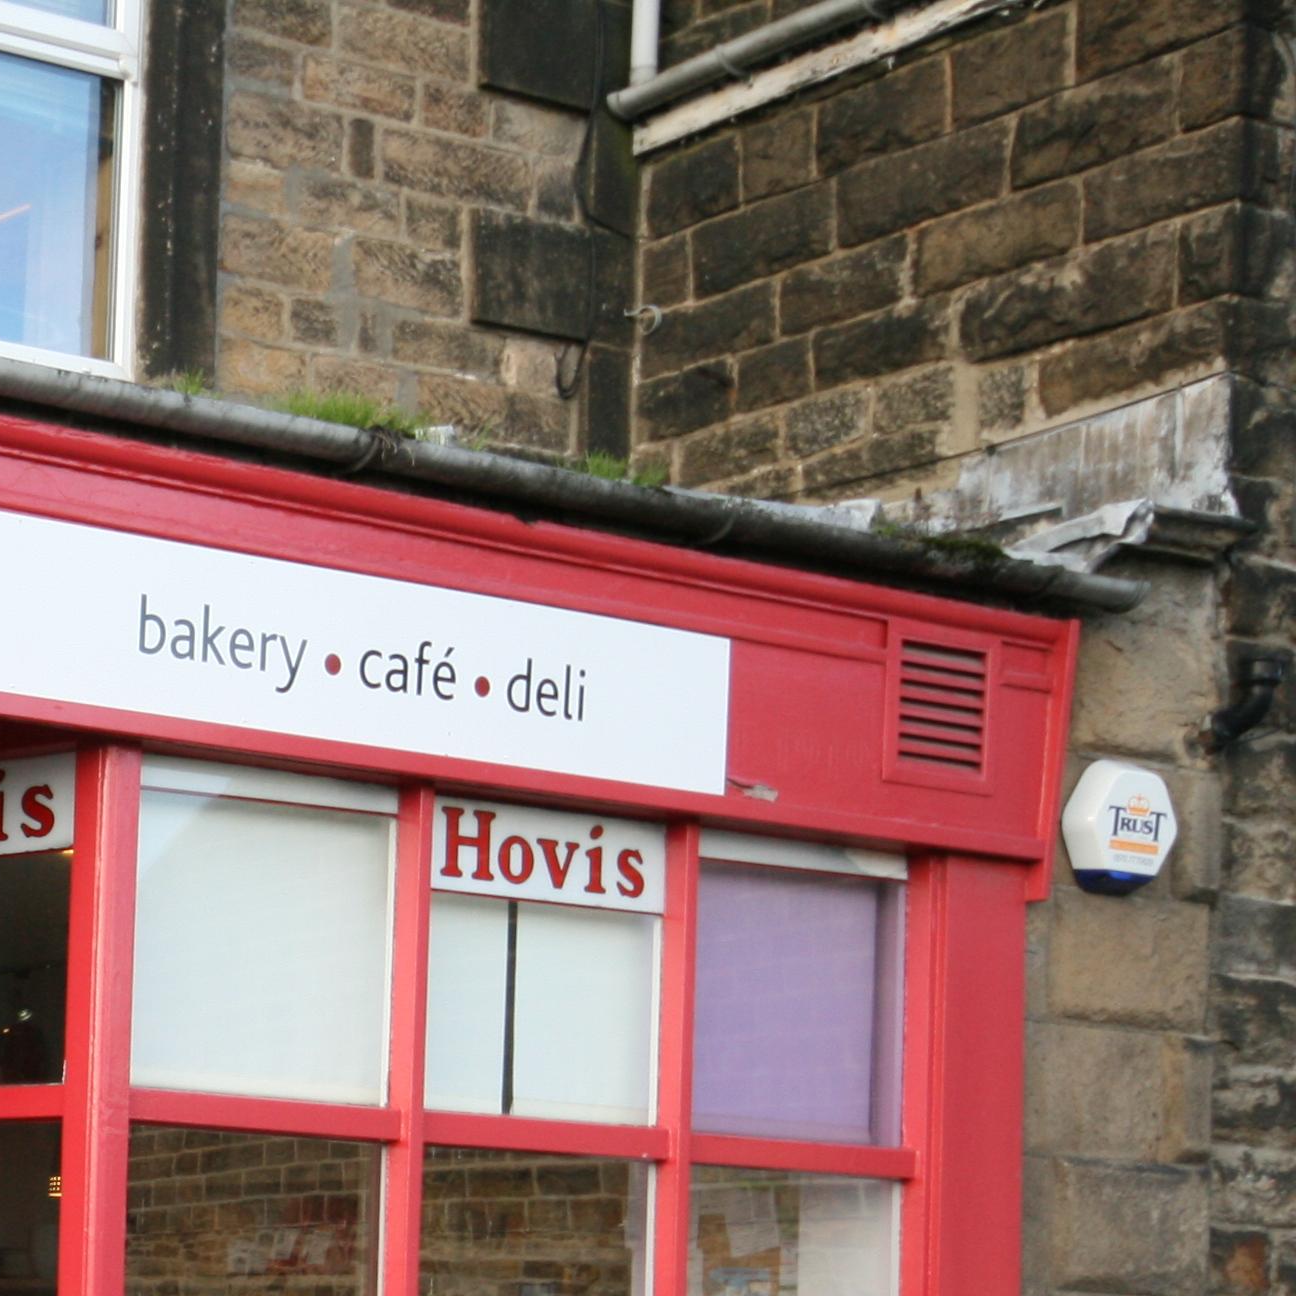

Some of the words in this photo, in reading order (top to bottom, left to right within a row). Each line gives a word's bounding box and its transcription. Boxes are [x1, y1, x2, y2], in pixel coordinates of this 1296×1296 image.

[138, 594, 307, 693] bakery
[359, 641, 456, 700] café
[507, 658, 586, 721] deli
[440, 806, 644, 898] Hovis
[1109, 805, 1167, 842] TRUST
